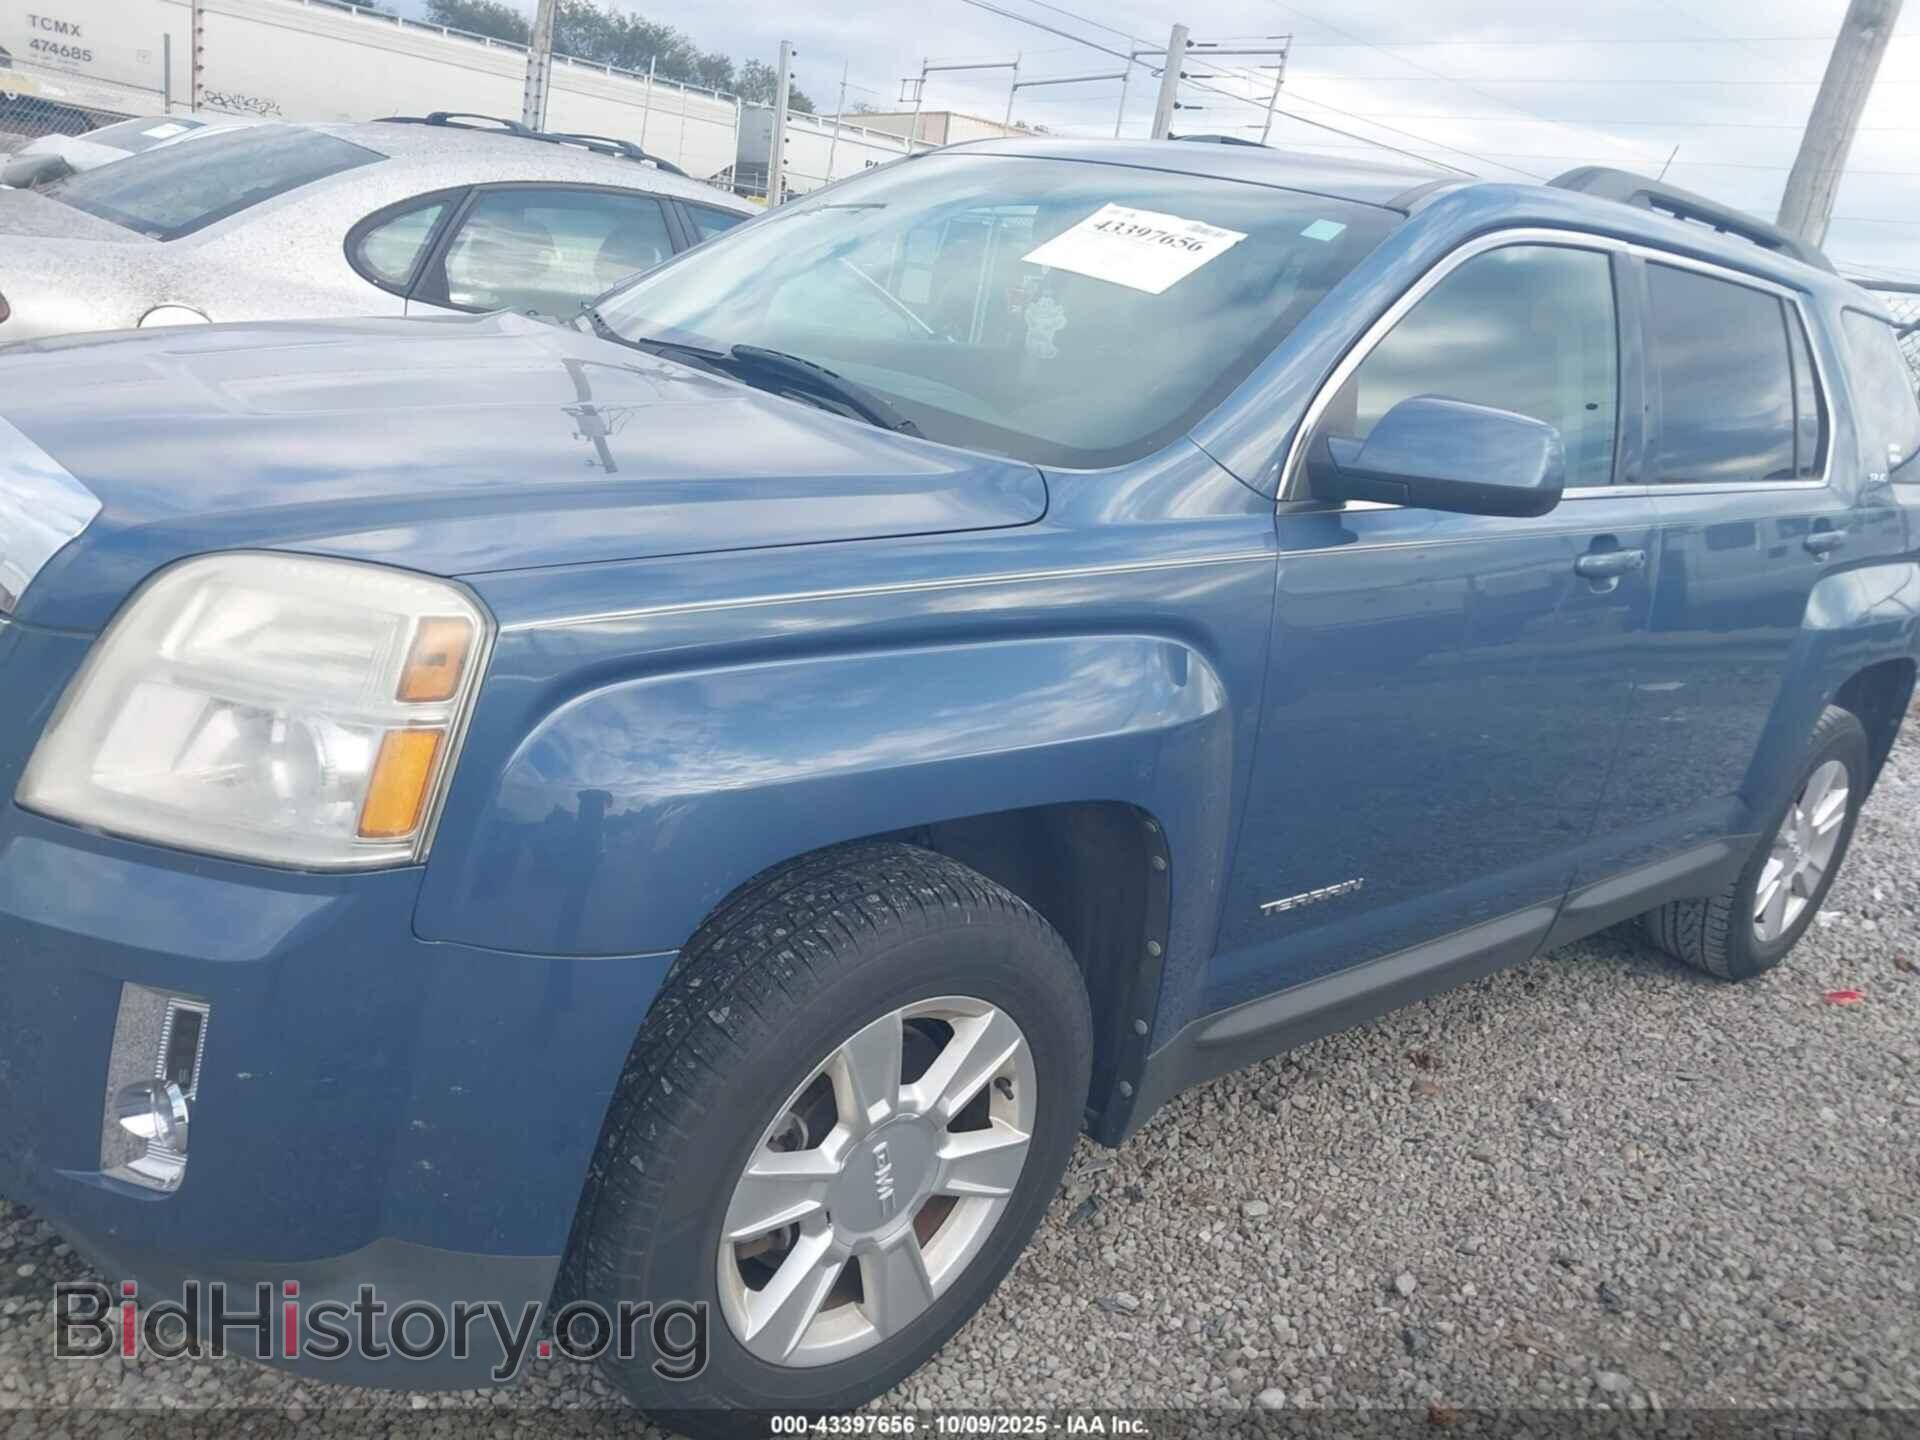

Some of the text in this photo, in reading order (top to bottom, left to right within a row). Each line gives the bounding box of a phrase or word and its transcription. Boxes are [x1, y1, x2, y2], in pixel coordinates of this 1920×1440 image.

[27, 13, 81, 37] TCMX
[29, 38, 93, 62] 474685
[1094, 220, 1206, 251] 43397656
[1259, 876, 1364, 916] TERRAIN
